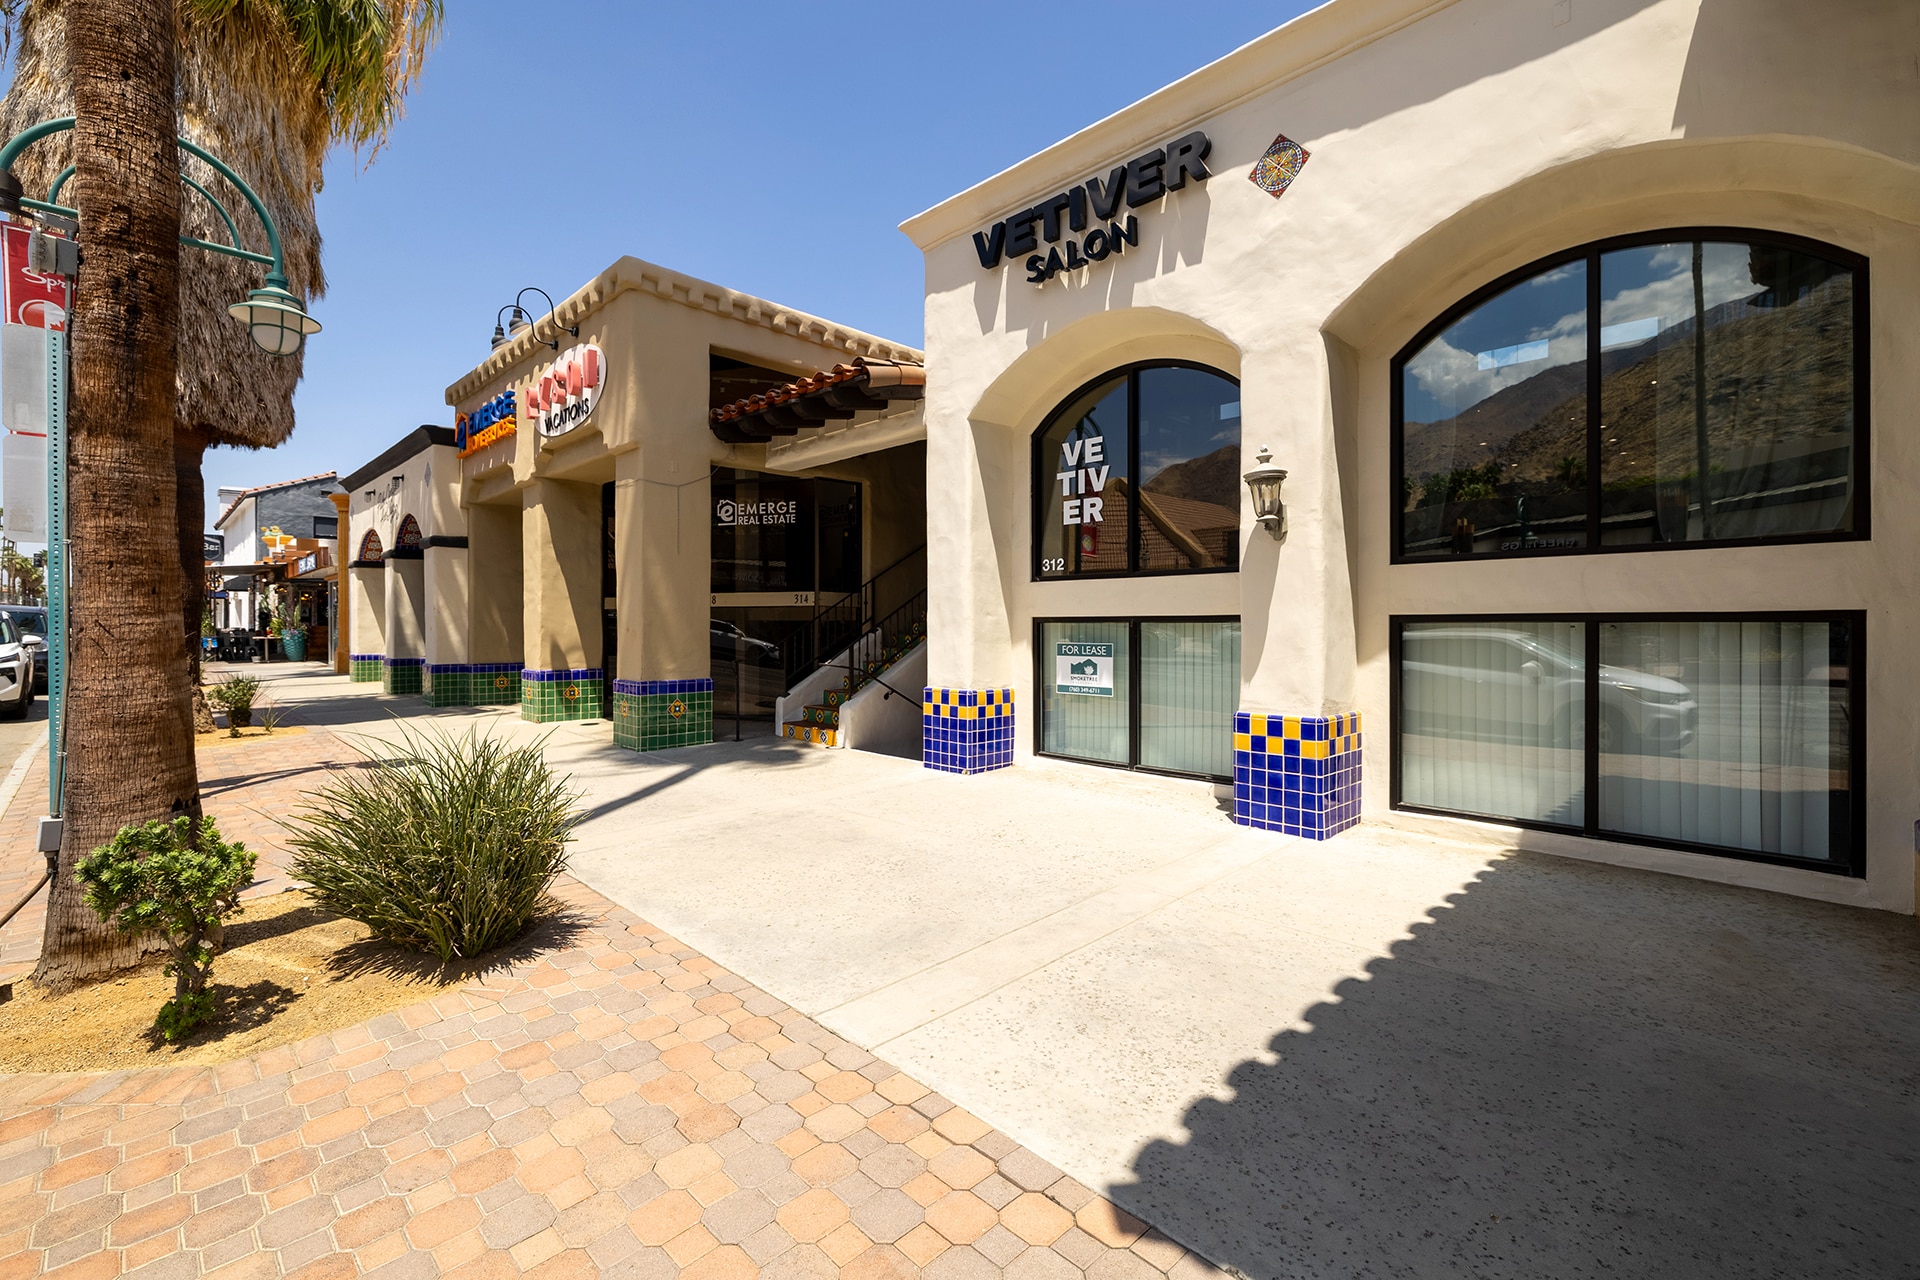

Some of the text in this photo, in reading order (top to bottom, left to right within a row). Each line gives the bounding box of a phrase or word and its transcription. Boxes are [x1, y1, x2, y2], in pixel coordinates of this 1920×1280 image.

[972, 131, 1213, 270] VETIVER
[1026, 215, 1138, 283] SALON
[468, 390, 516, 435] EMERGE
[544, 397, 590, 434] VACATIONS
[1062, 435, 1104, 466] VE
[1056, 464, 1110, 496] TIV
[738, 501, 796, 515] EMERGE
[738, 513, 796, 525] REAL ESTATE
[1063, 496, 1104, 526] ER
[1042, 558, 1065, 571] 312
[794, 593, 809, 604] 314
[1062, 645, 1107, 656] FOR LEASE
